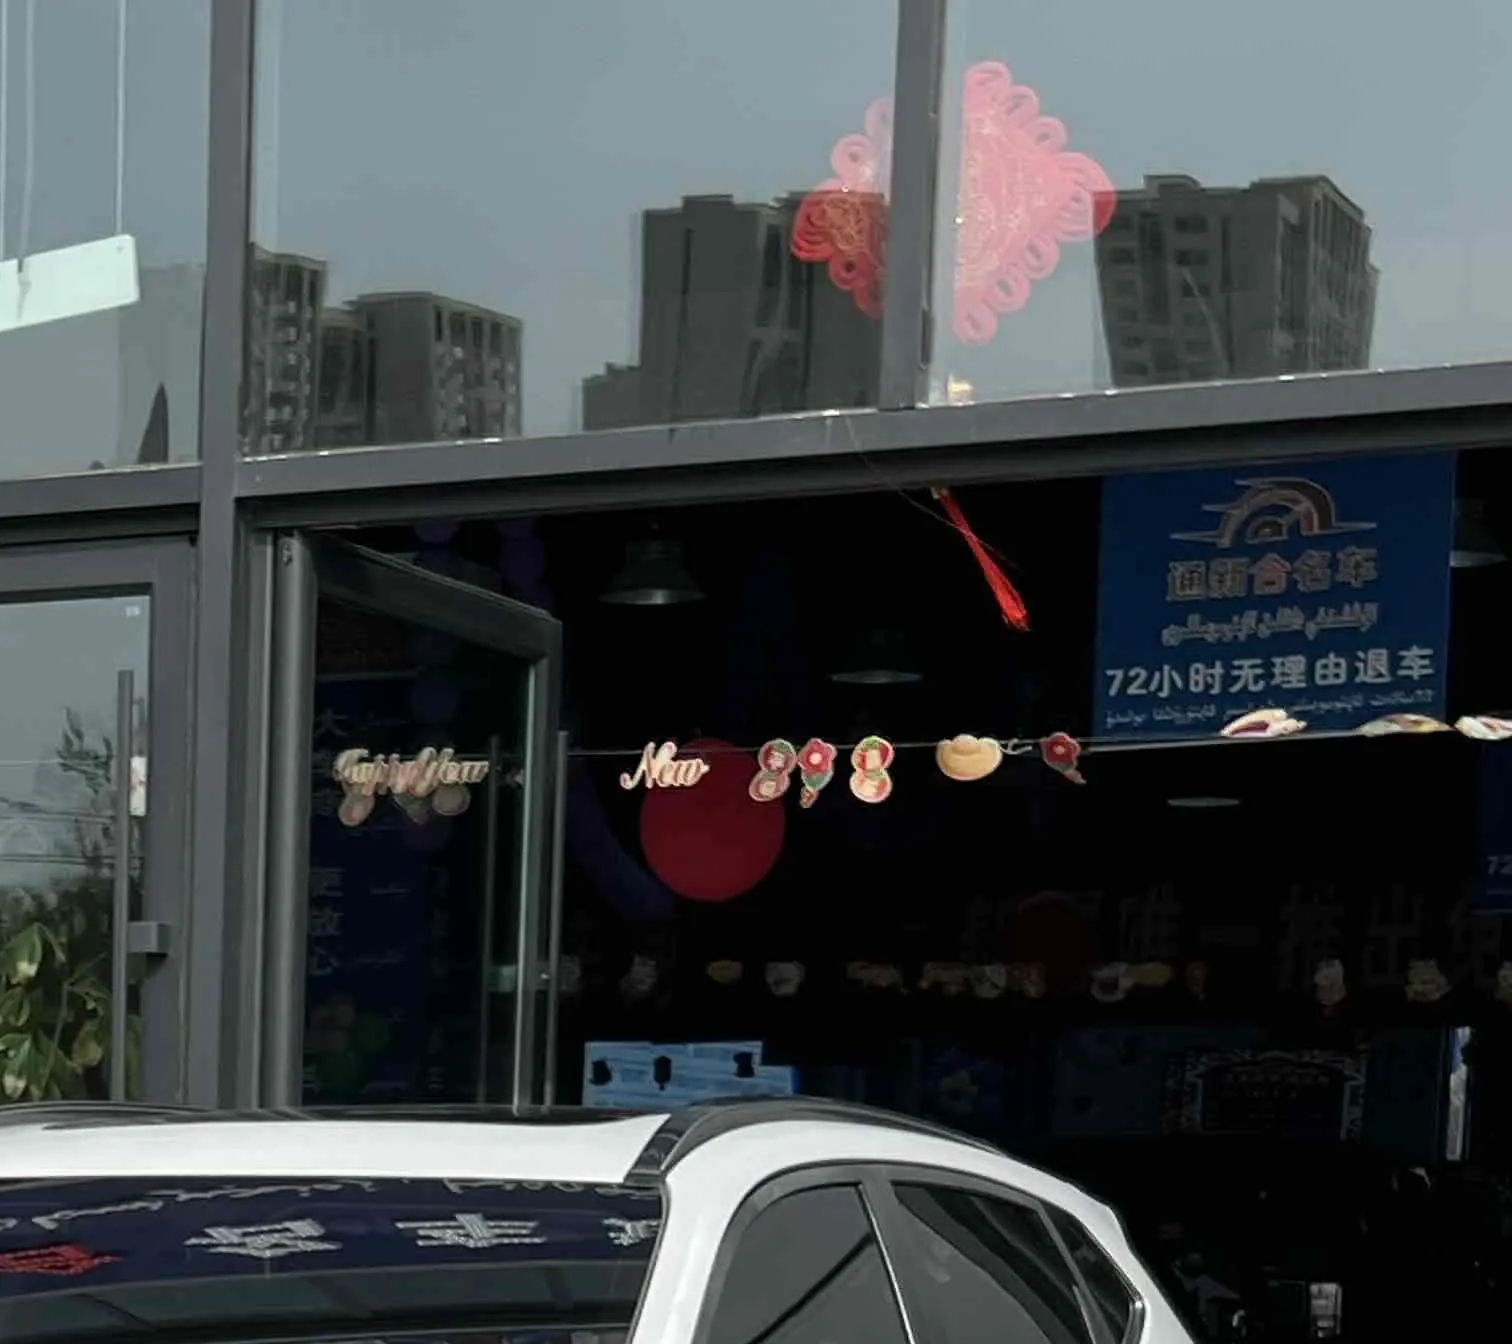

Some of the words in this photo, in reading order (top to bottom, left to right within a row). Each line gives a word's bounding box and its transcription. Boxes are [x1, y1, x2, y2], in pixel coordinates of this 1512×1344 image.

[1167, 545, 1379, 601] 通新合名车
[1104, 644, 1435, 698] 72小时无理由退车
[619, 741, 710, 789] New
